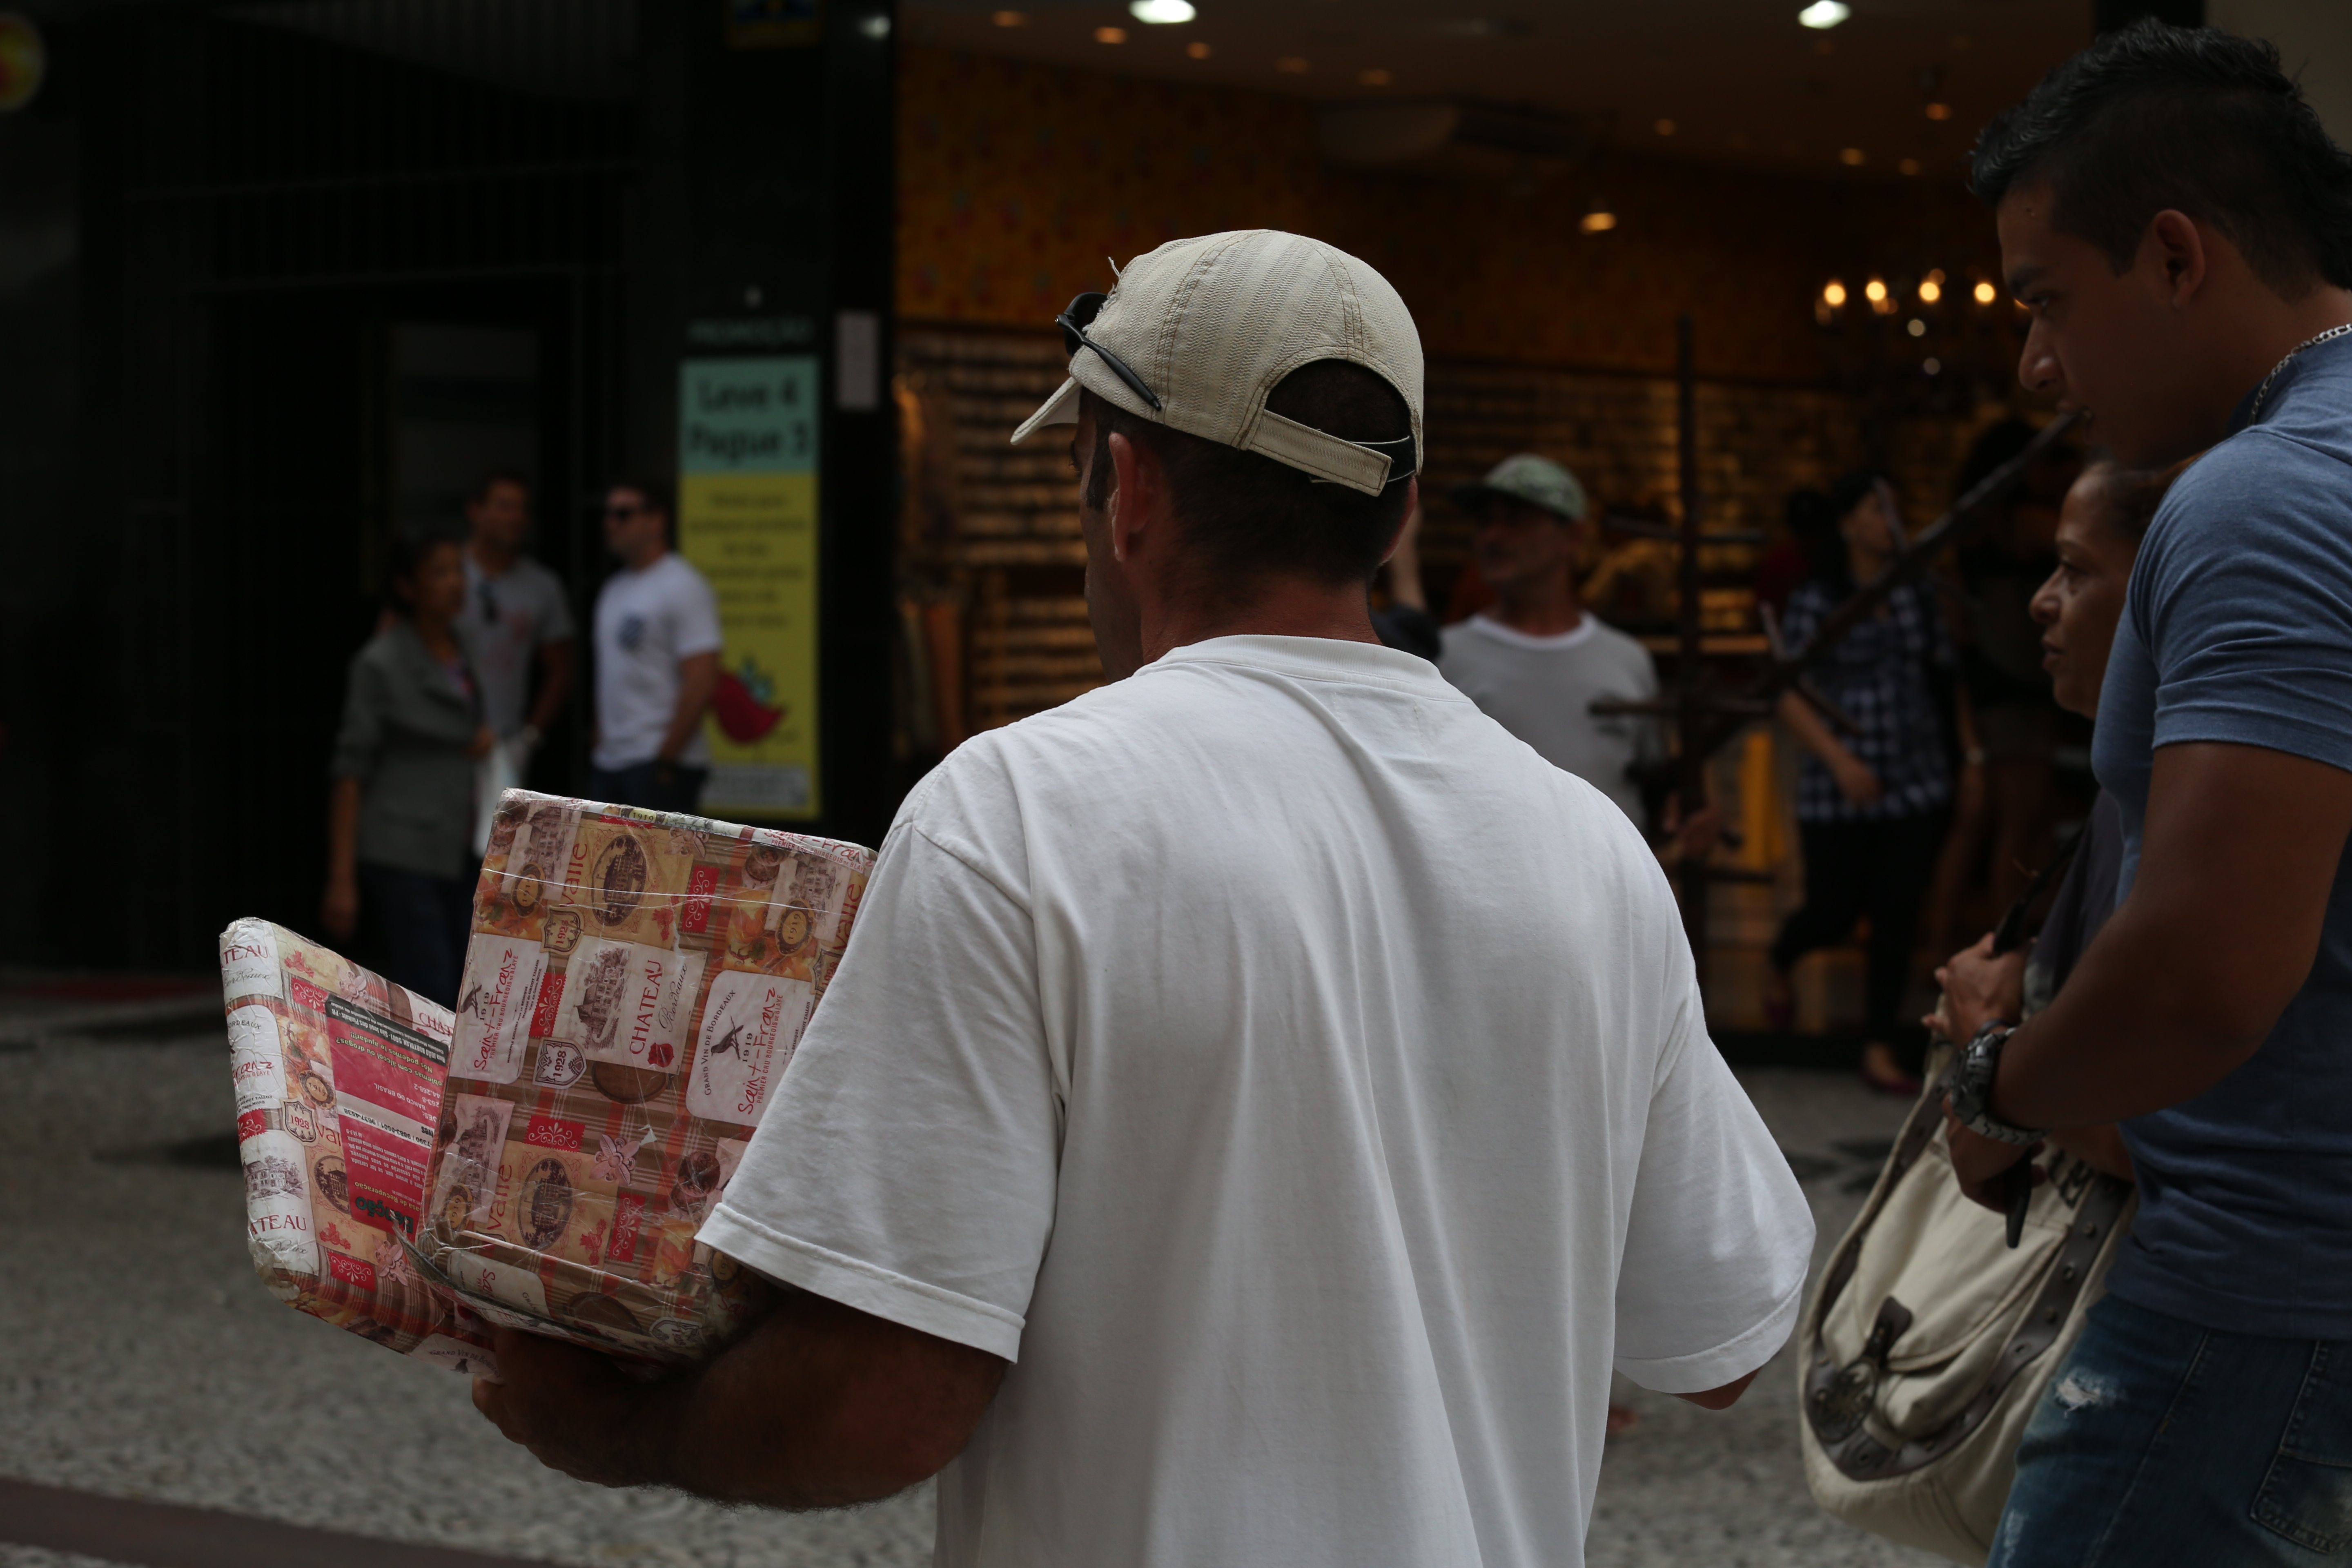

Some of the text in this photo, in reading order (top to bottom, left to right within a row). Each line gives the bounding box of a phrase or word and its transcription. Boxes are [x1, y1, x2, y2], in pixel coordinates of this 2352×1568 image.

[632, 812, 654, 822] 1919
[556, 920, 569, 944] 1928
[788, 913, 802, 940] 1919
[224, 945, 268, 965] TEAU
[480, 992, 490, 1021] 1919
[629, 960, 662, 1054] CHATEAU
[658, 963, 687, 1032] Bordeaux
[489, 1032, 499, 1059] PREMIER
[500, 981, 512, 1016] BOURGEOIS
[706, 990, 736, 1033] BORDEAUX
[419, 1012, 454, 1037] CHAT
[350, 1031, 378, 1047] ajudar!!!
[380, 1044, 387, 1052] te
[705, 1035, 710, 1045] DE
[742, 1032, 753, 1062] 1919
[757, 1078, 767, 1104] PREMIER
[766, 1022, 778, 1059] BOURGEOIS
[775, 994, 784, 1015] BLAYE
[335, 1036, 442, 1087] oblemas com álcool ou drogas?
[388, 1048, 418, 1065] podemos
[552, 1050, 567, 1078] 1928
[308, 1082, 327, 1096] 1919
[703, 1066, 712, 1095] GRAND
[373, 1082, 425, 1111] BANCO DO BRASIL
[290, 1114, 310, 1130] 1928
[354, 1181, 397, 1203] Recuperação
[400, 1198, 407, 1207] de
[408, 1203, 420, 1212] asa
[251, 1214, 307, 1235] ATEAU
